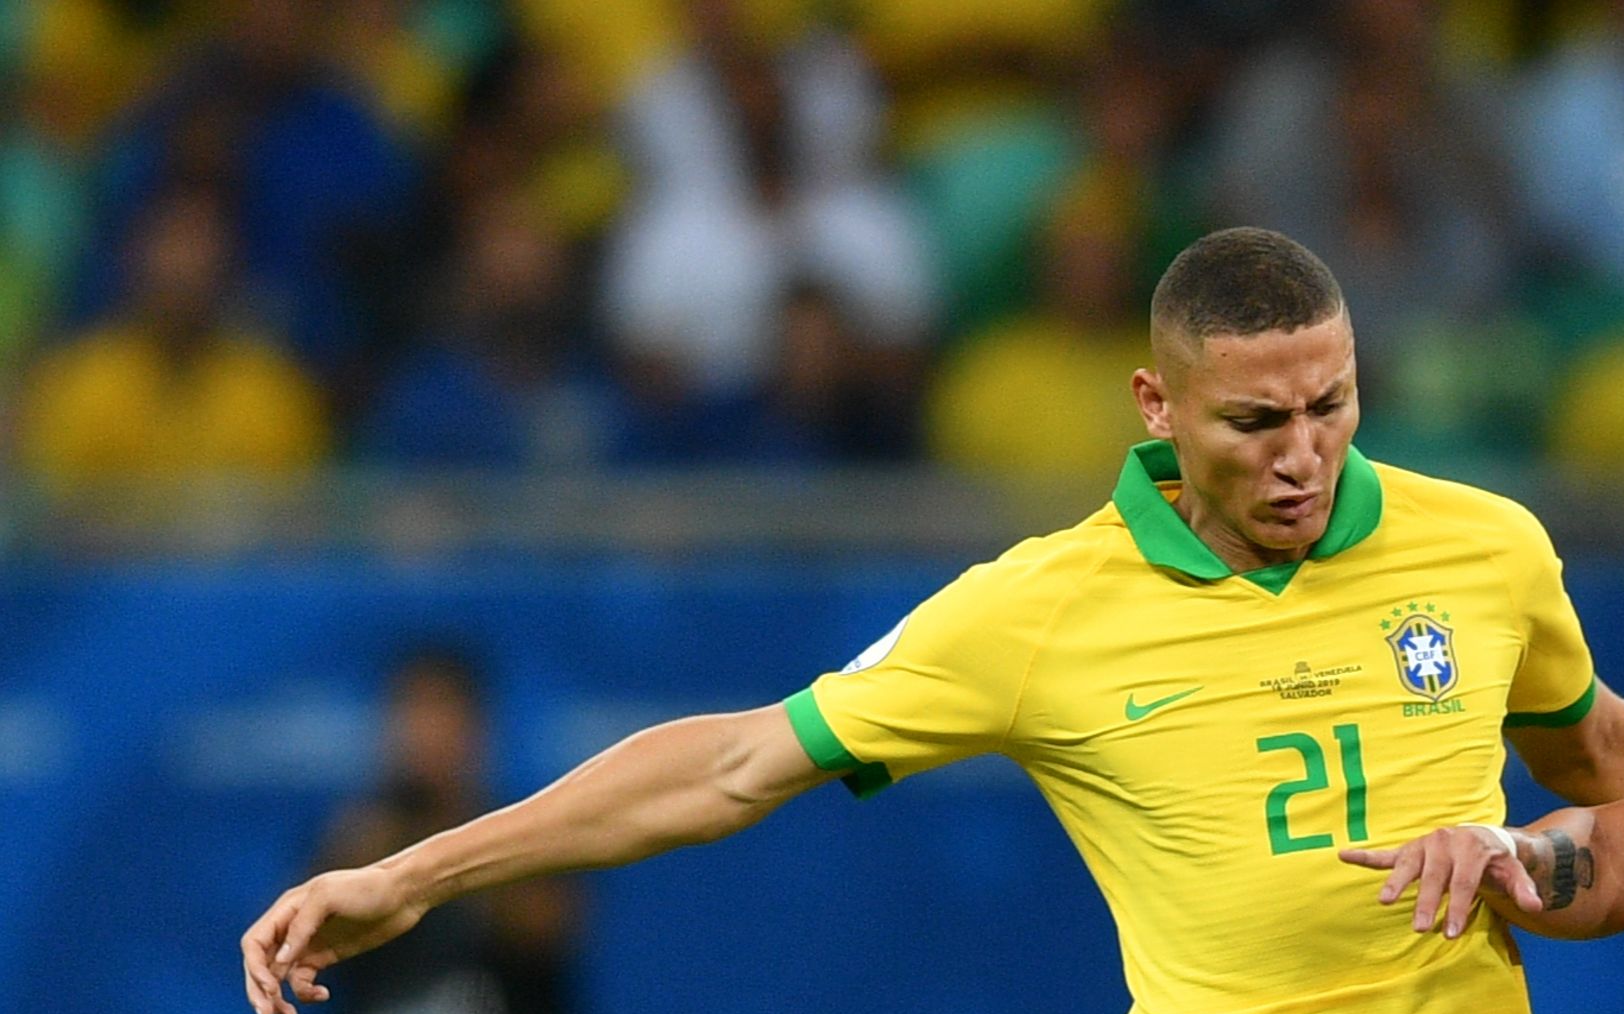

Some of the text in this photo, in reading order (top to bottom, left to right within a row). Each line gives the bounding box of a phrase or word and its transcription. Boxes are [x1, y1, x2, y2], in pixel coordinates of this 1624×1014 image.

[1314, 665, 1362, 678] VENEZUELA
[1403, 699, 1466, 717] BRASIL
[1256, 723, 1369, 855] 21
